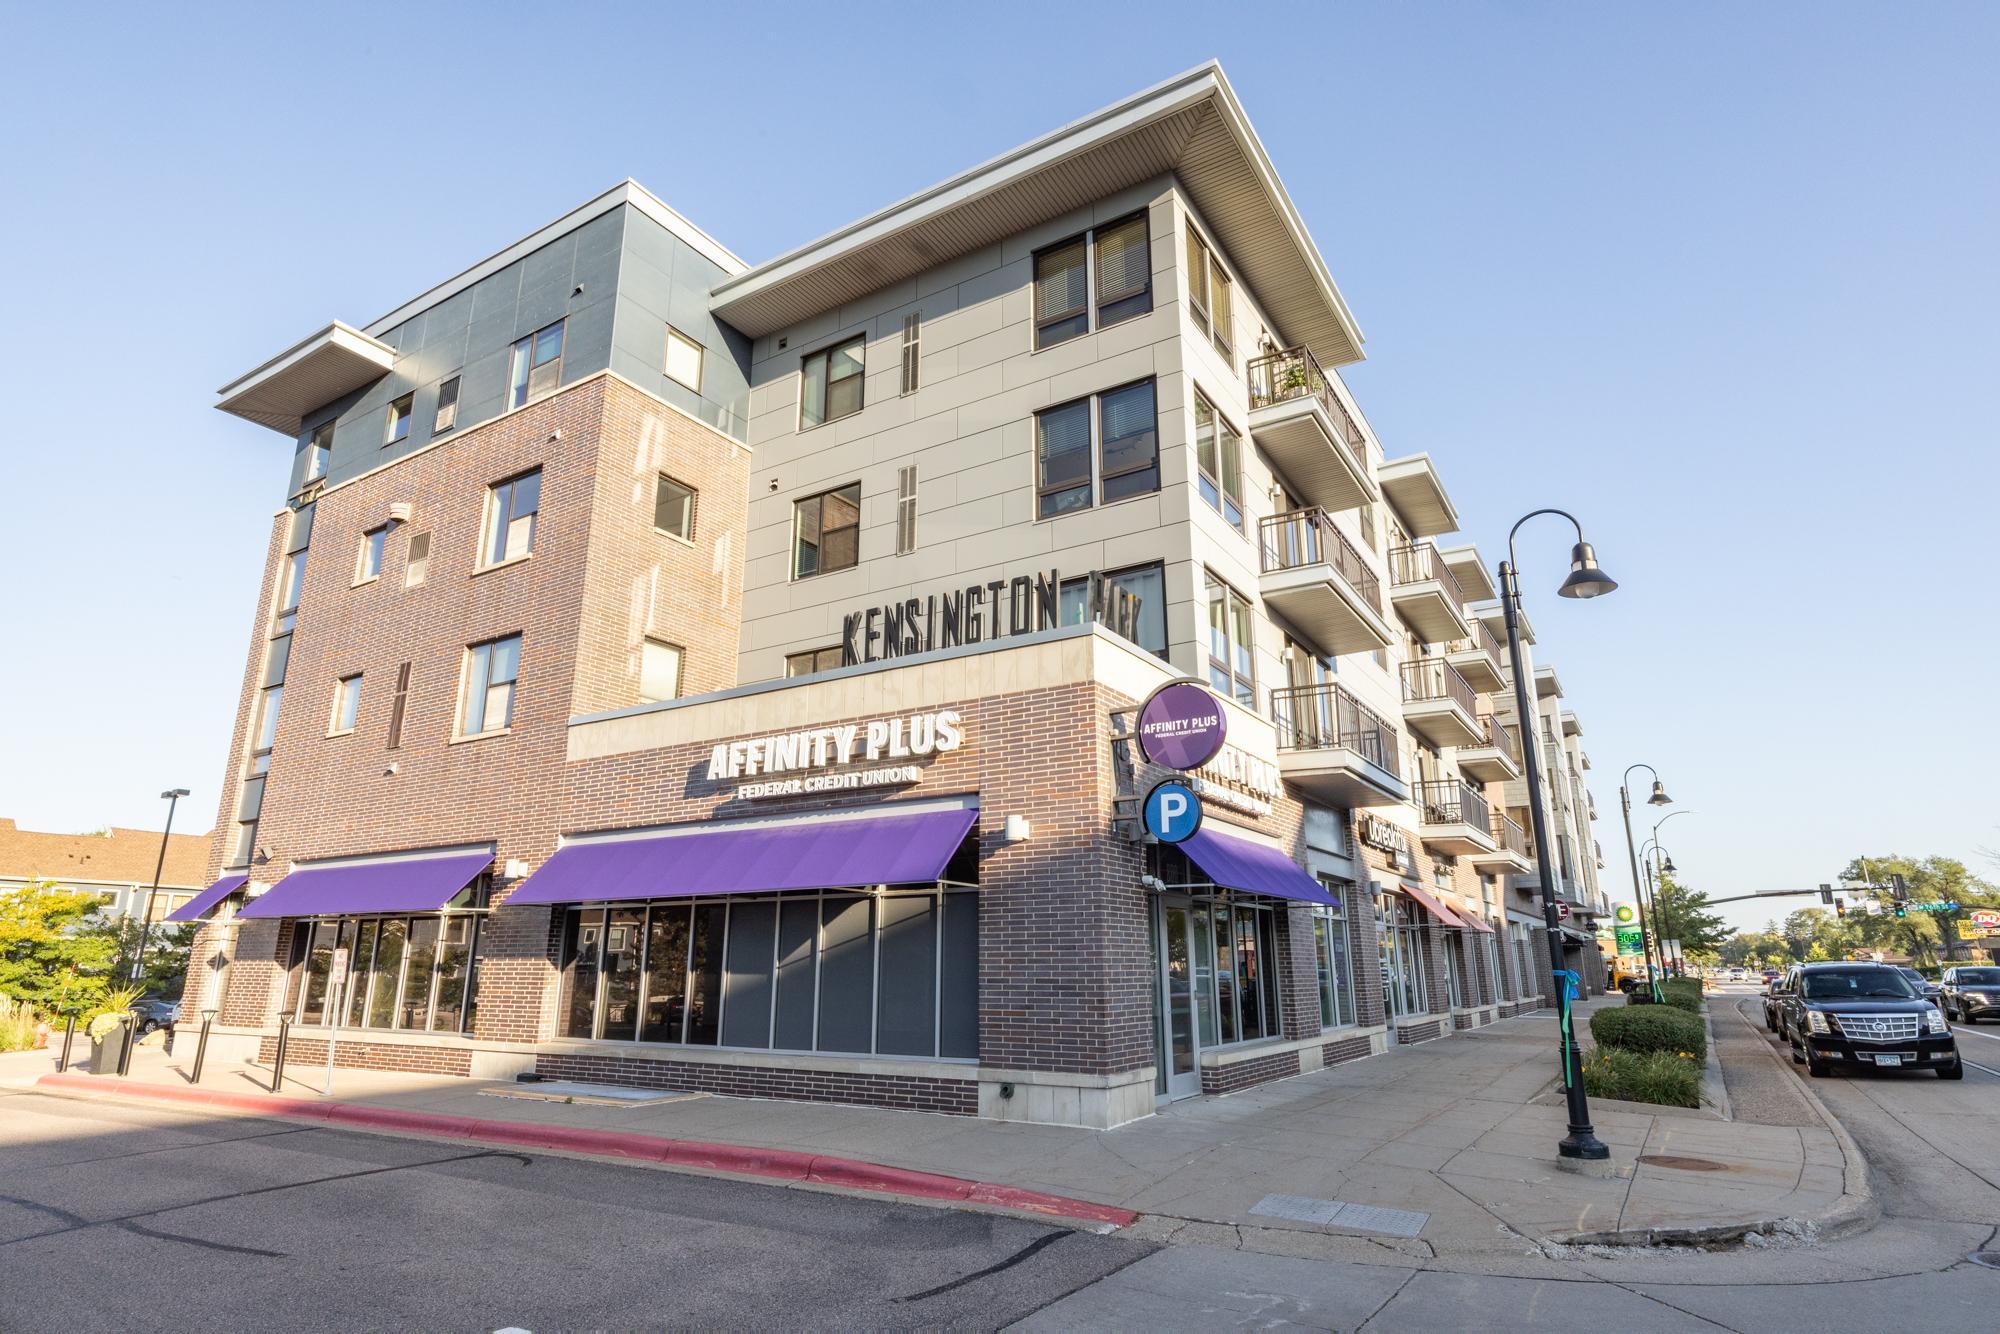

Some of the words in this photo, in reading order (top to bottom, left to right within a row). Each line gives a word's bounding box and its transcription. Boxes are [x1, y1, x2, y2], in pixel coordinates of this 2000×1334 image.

[842, 568, 1059, 667] KENSINGTON
[1088, 570, 1142, 646] PARK
[1144, 719, 1189, 735] AFFINITY
[1192, 715, 1218, 729] PLUS
[707, 724, 858, 780] AFFINITY
[866, 711, 961, 760] PLUS
[738, 777, 802, 799] FEDERAL
[804, 771, 862, 793] CREDIT
[862, 766, 914, 787] UNION
[1161, 793, 1187, 833] P
[1977, 914, 1998, 923] DQ
